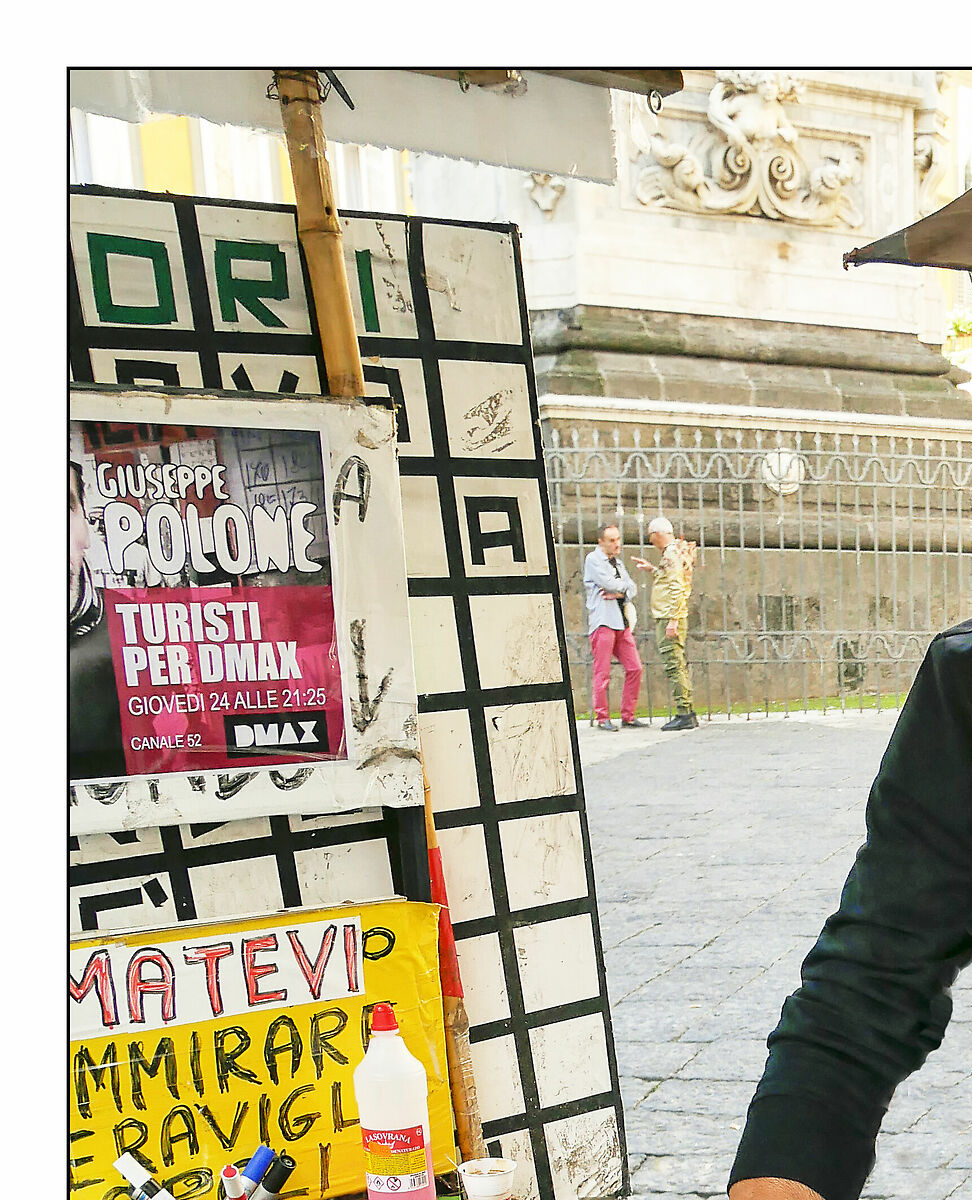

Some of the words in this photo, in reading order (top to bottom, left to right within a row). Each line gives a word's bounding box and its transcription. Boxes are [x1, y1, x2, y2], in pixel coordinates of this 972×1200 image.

[96, 462, 230, 500] GIUSEPPE
[102, 500, 324, 577] POLONE
[115, 601, 263, 645] TURISTI
[122, 645, 193, 687] PER
[198, 641, 303, 684] DMAX
[210, 693, 231, 711] 24
[233, 691, 279, 710] ALLE
[283, 688, 327, 708] 21:25
[130, 734, 185, 751] CANALE
[186, 733, 202, 748] 52
[233, 720, 320, 748] DMAX
[365, 1132, 411, 1144] LASOVRANA
